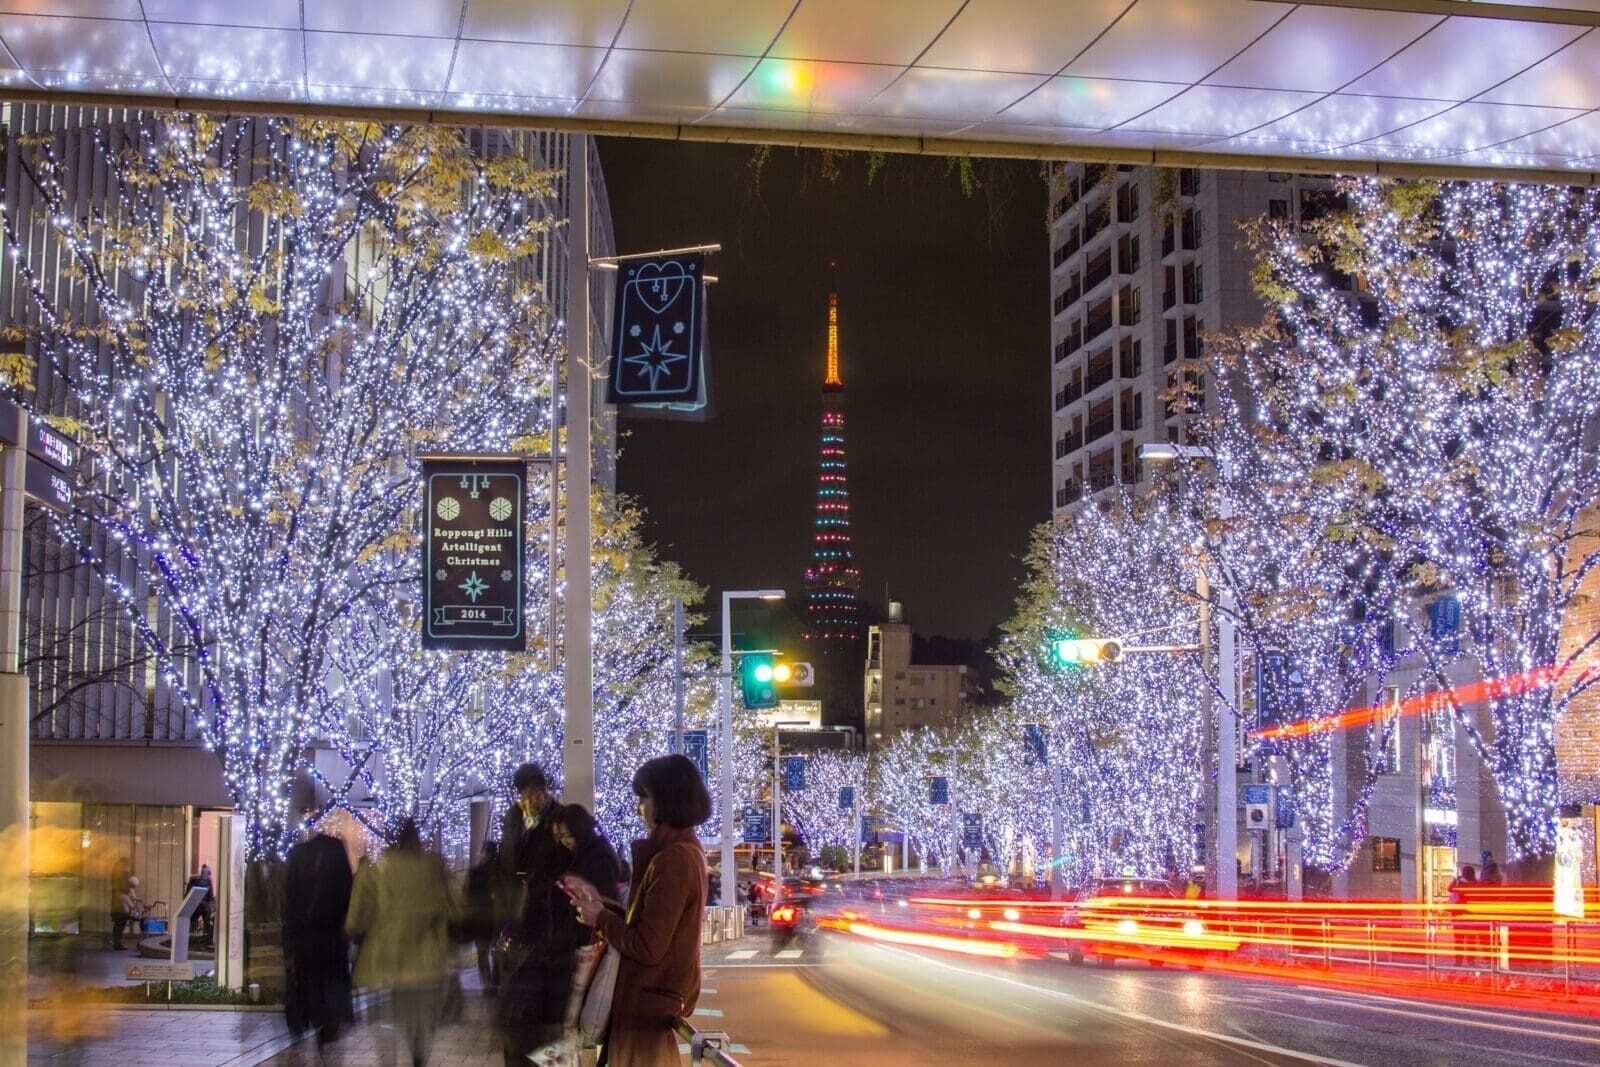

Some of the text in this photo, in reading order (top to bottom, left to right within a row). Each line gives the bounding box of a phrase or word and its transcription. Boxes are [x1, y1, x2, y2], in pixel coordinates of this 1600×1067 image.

[434, 528, 513, 539] Roppongi Hills
[442, 543, 502, 553] Artelligent
[447, 557, 501, 566] Christmas
[461, 610, 486, 619] 2014
